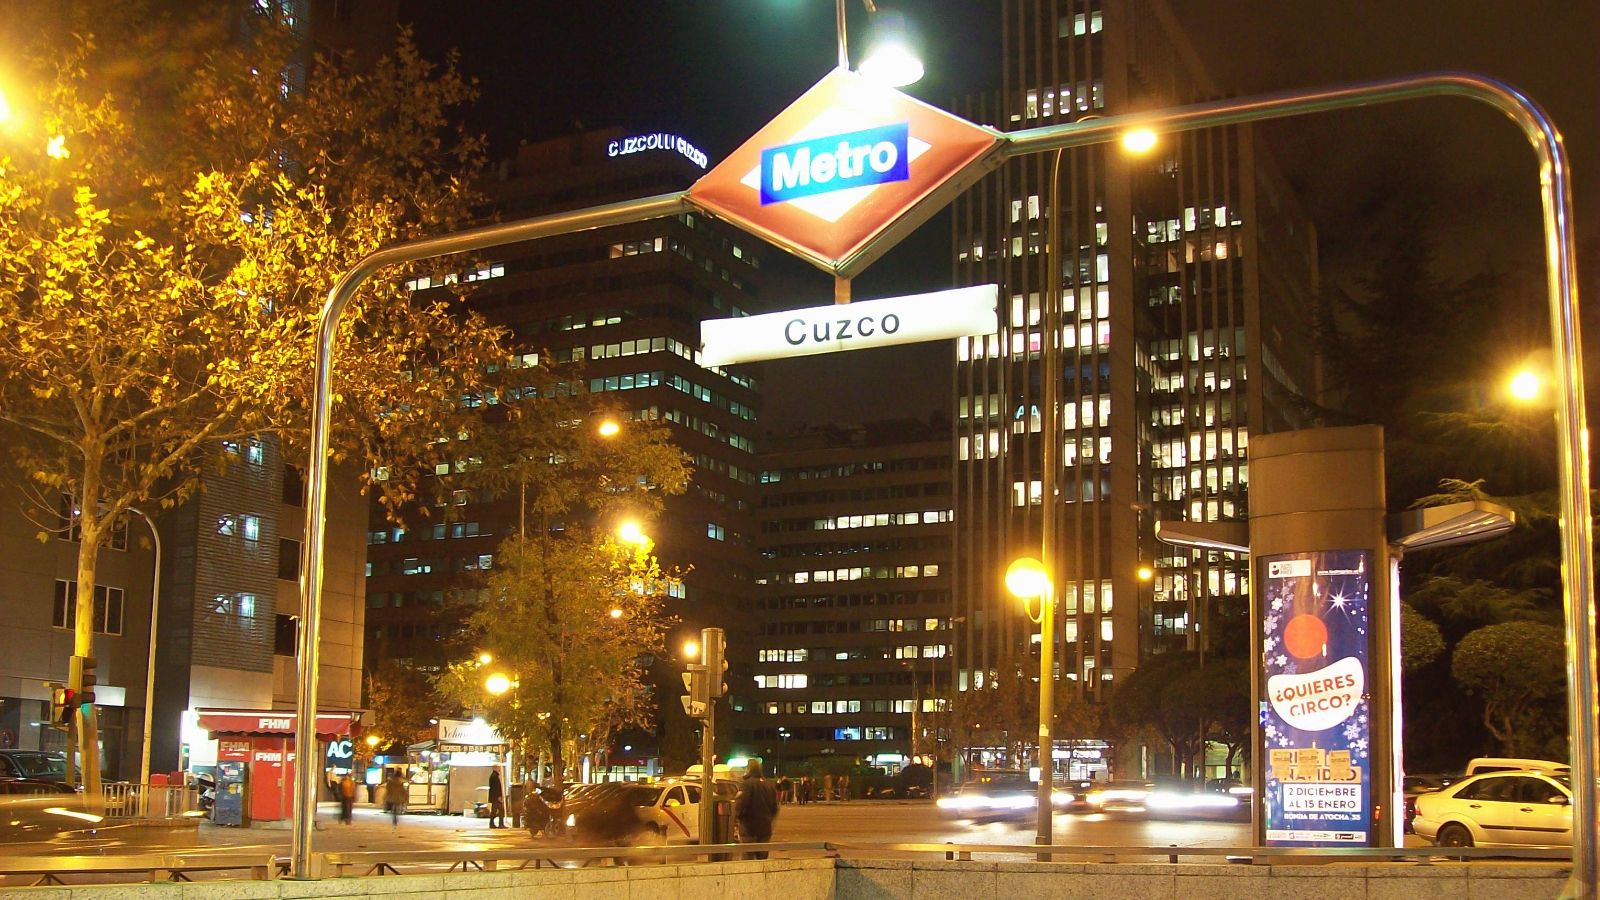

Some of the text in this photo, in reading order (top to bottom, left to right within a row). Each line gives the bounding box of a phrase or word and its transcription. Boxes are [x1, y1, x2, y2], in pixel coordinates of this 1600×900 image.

[772, 140, 898, 192] Metro
[784, 313, 900, 346] Cuzco
[1276, 674, 1355, 702] ¿QUIERES
[1289, 693, 1352, 717] CIRCO?
[258, 718, 291, 729] FHM
[255, 752, 282, 762] FHM
[327, 740, 353, 759] AC
[1288, 787, 1357, 797] 2 DICIEMBRE
[1288, 800, 1357, 809] AL 15 ENERO
